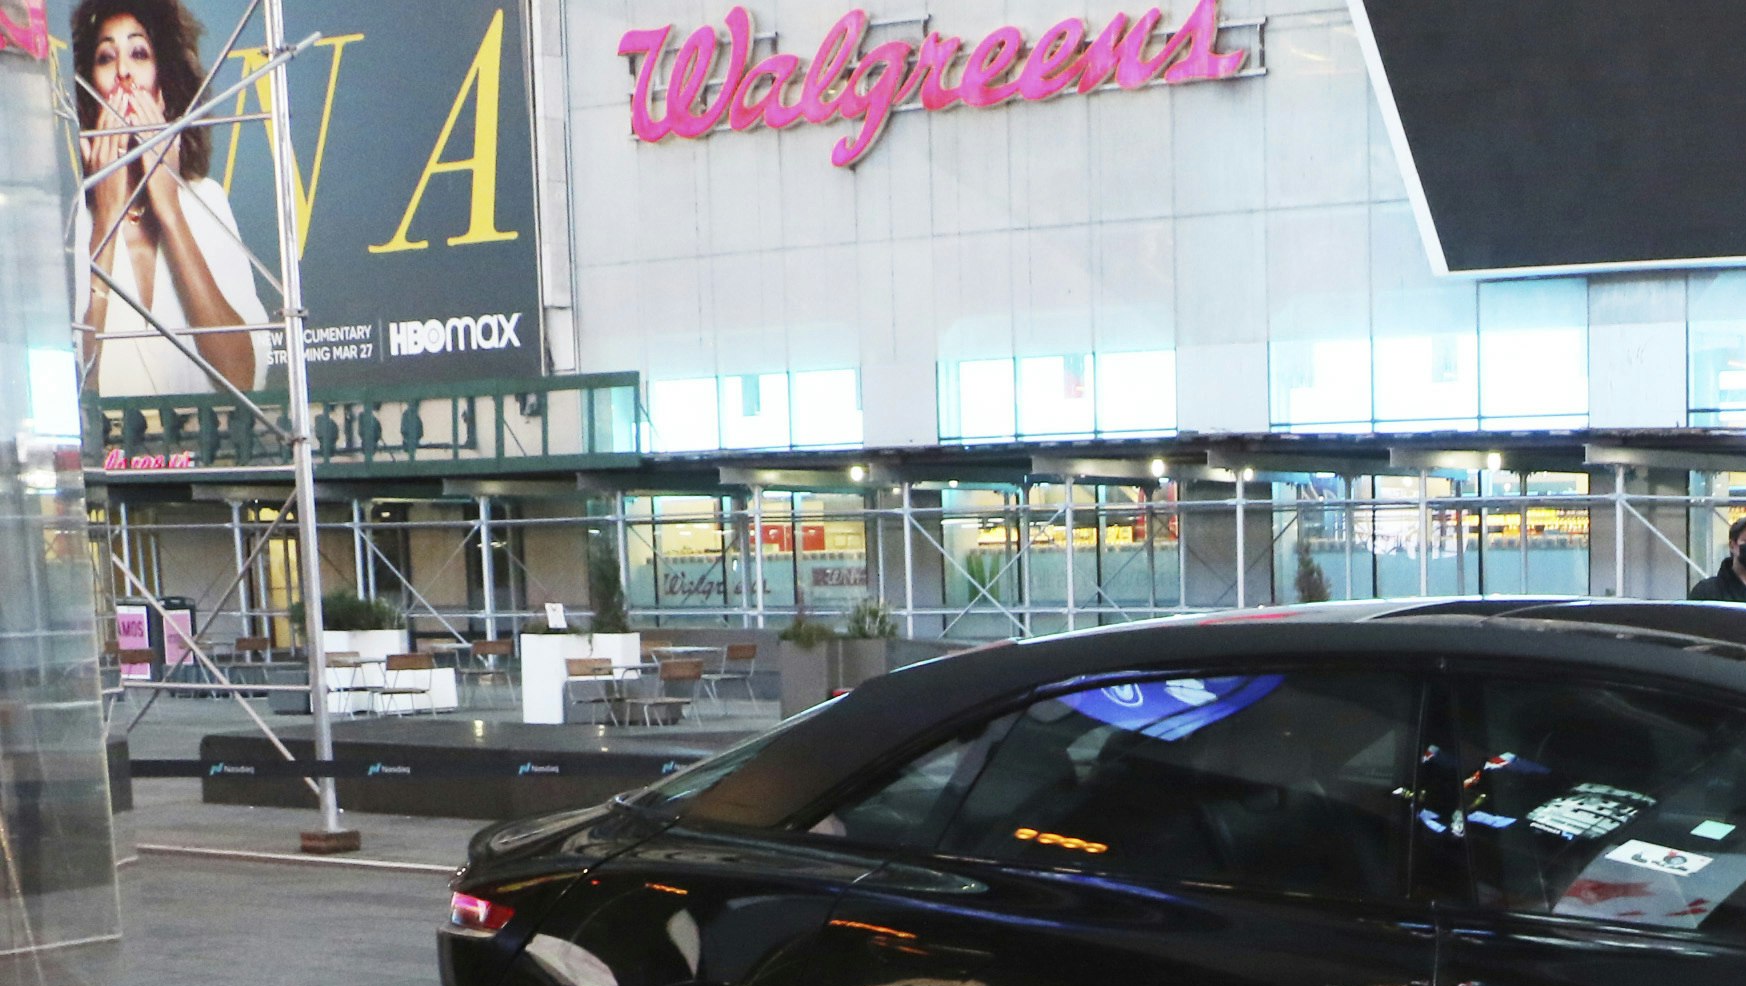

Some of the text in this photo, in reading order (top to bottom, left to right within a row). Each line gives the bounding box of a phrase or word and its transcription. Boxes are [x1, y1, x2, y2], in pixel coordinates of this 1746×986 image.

[617, 0, 1244, 169] Walgreens
[258, 324, 372, 347] EW CUMENTARY
[267, 343, 373, 366] STRMING MAR 27
